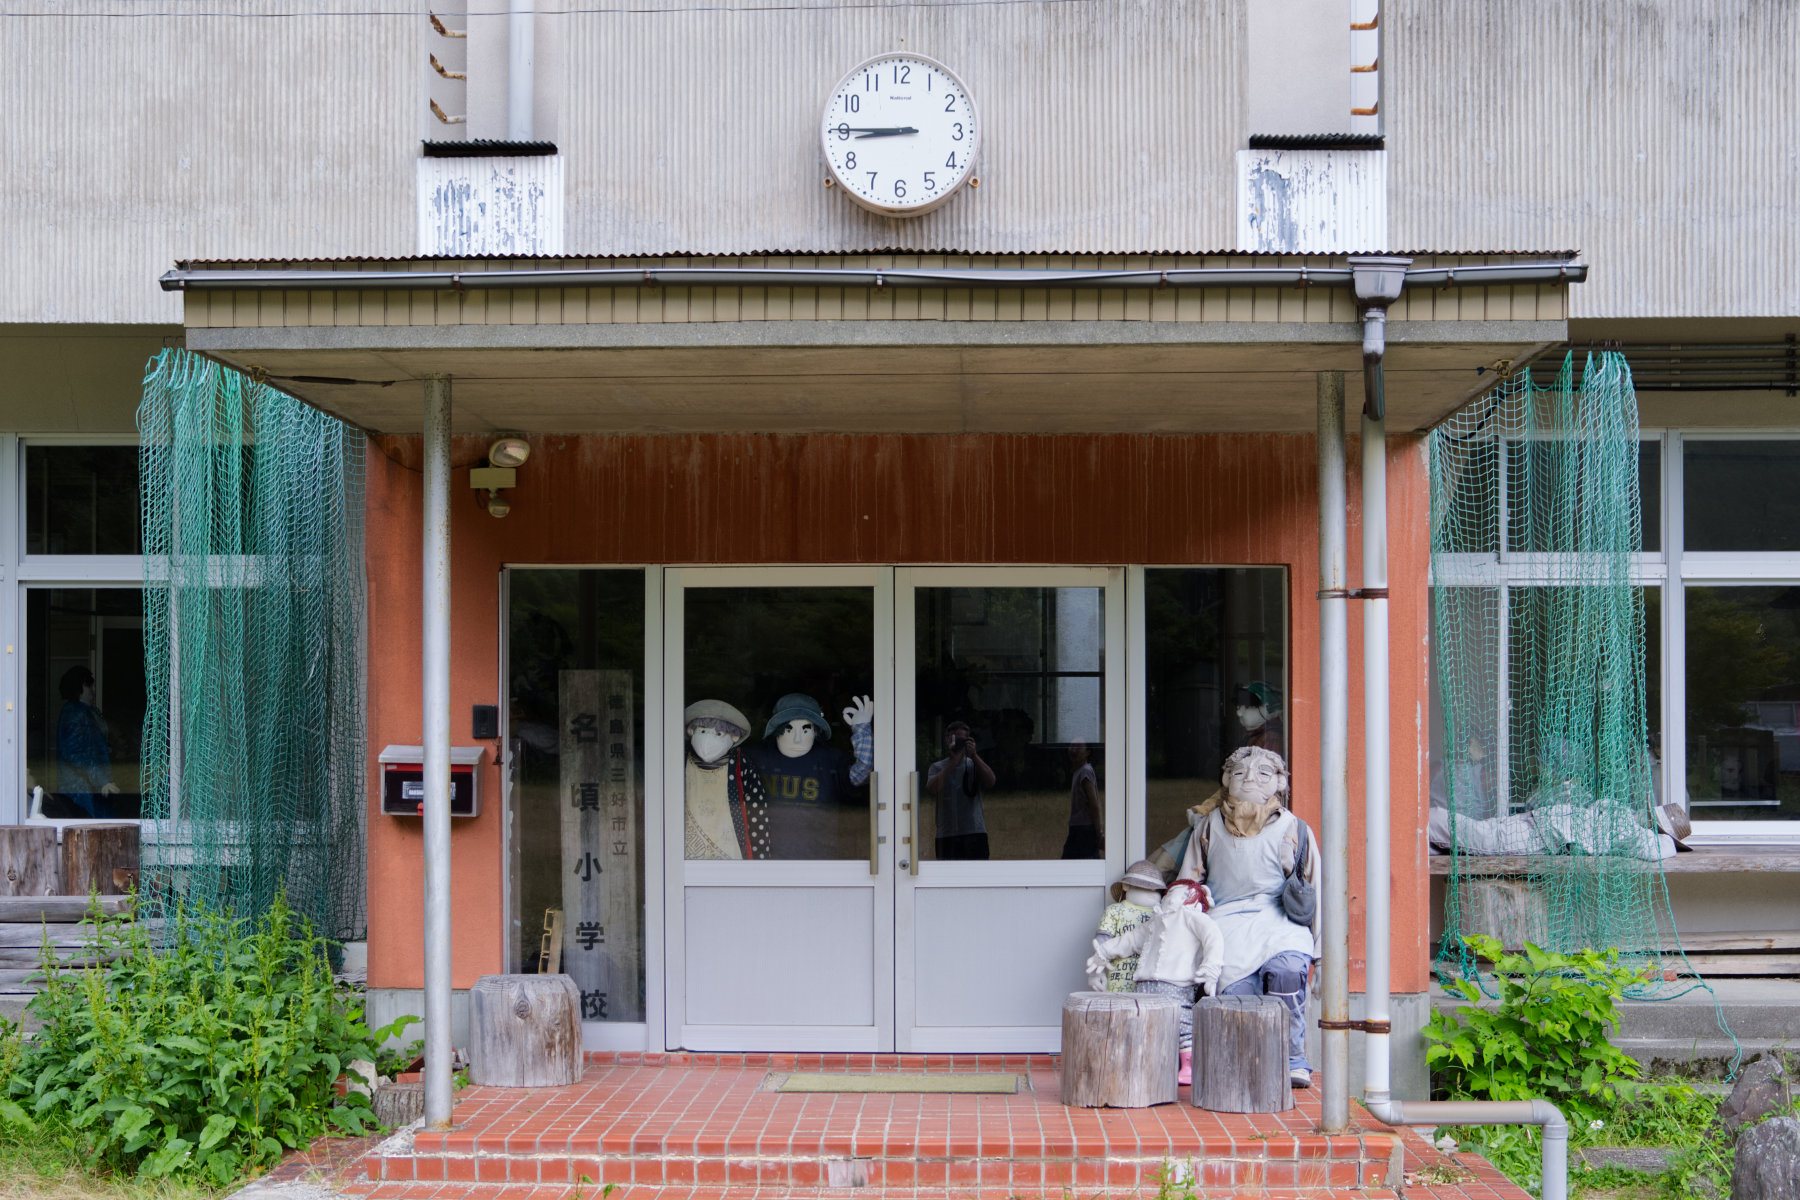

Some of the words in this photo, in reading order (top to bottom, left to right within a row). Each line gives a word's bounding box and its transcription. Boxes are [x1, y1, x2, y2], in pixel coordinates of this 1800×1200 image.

[866, 73, 878, 92] 11
[894, 65, 911, 84] 12
[845, 94, 860, 113] 10
[944, 93, 956, 113] 2
[838, 122, 850, 141] 9
[952, 122, 964, 141] 3
[845, 151, 857, 170] 8
[945, 151, 957, 170] 4
[866, 171, 878, 190] 7
[894, 179, 907, 198] 6
[924, 171, 936, 190] 5
[570, 713, 608, 1019] 名頃小学校
